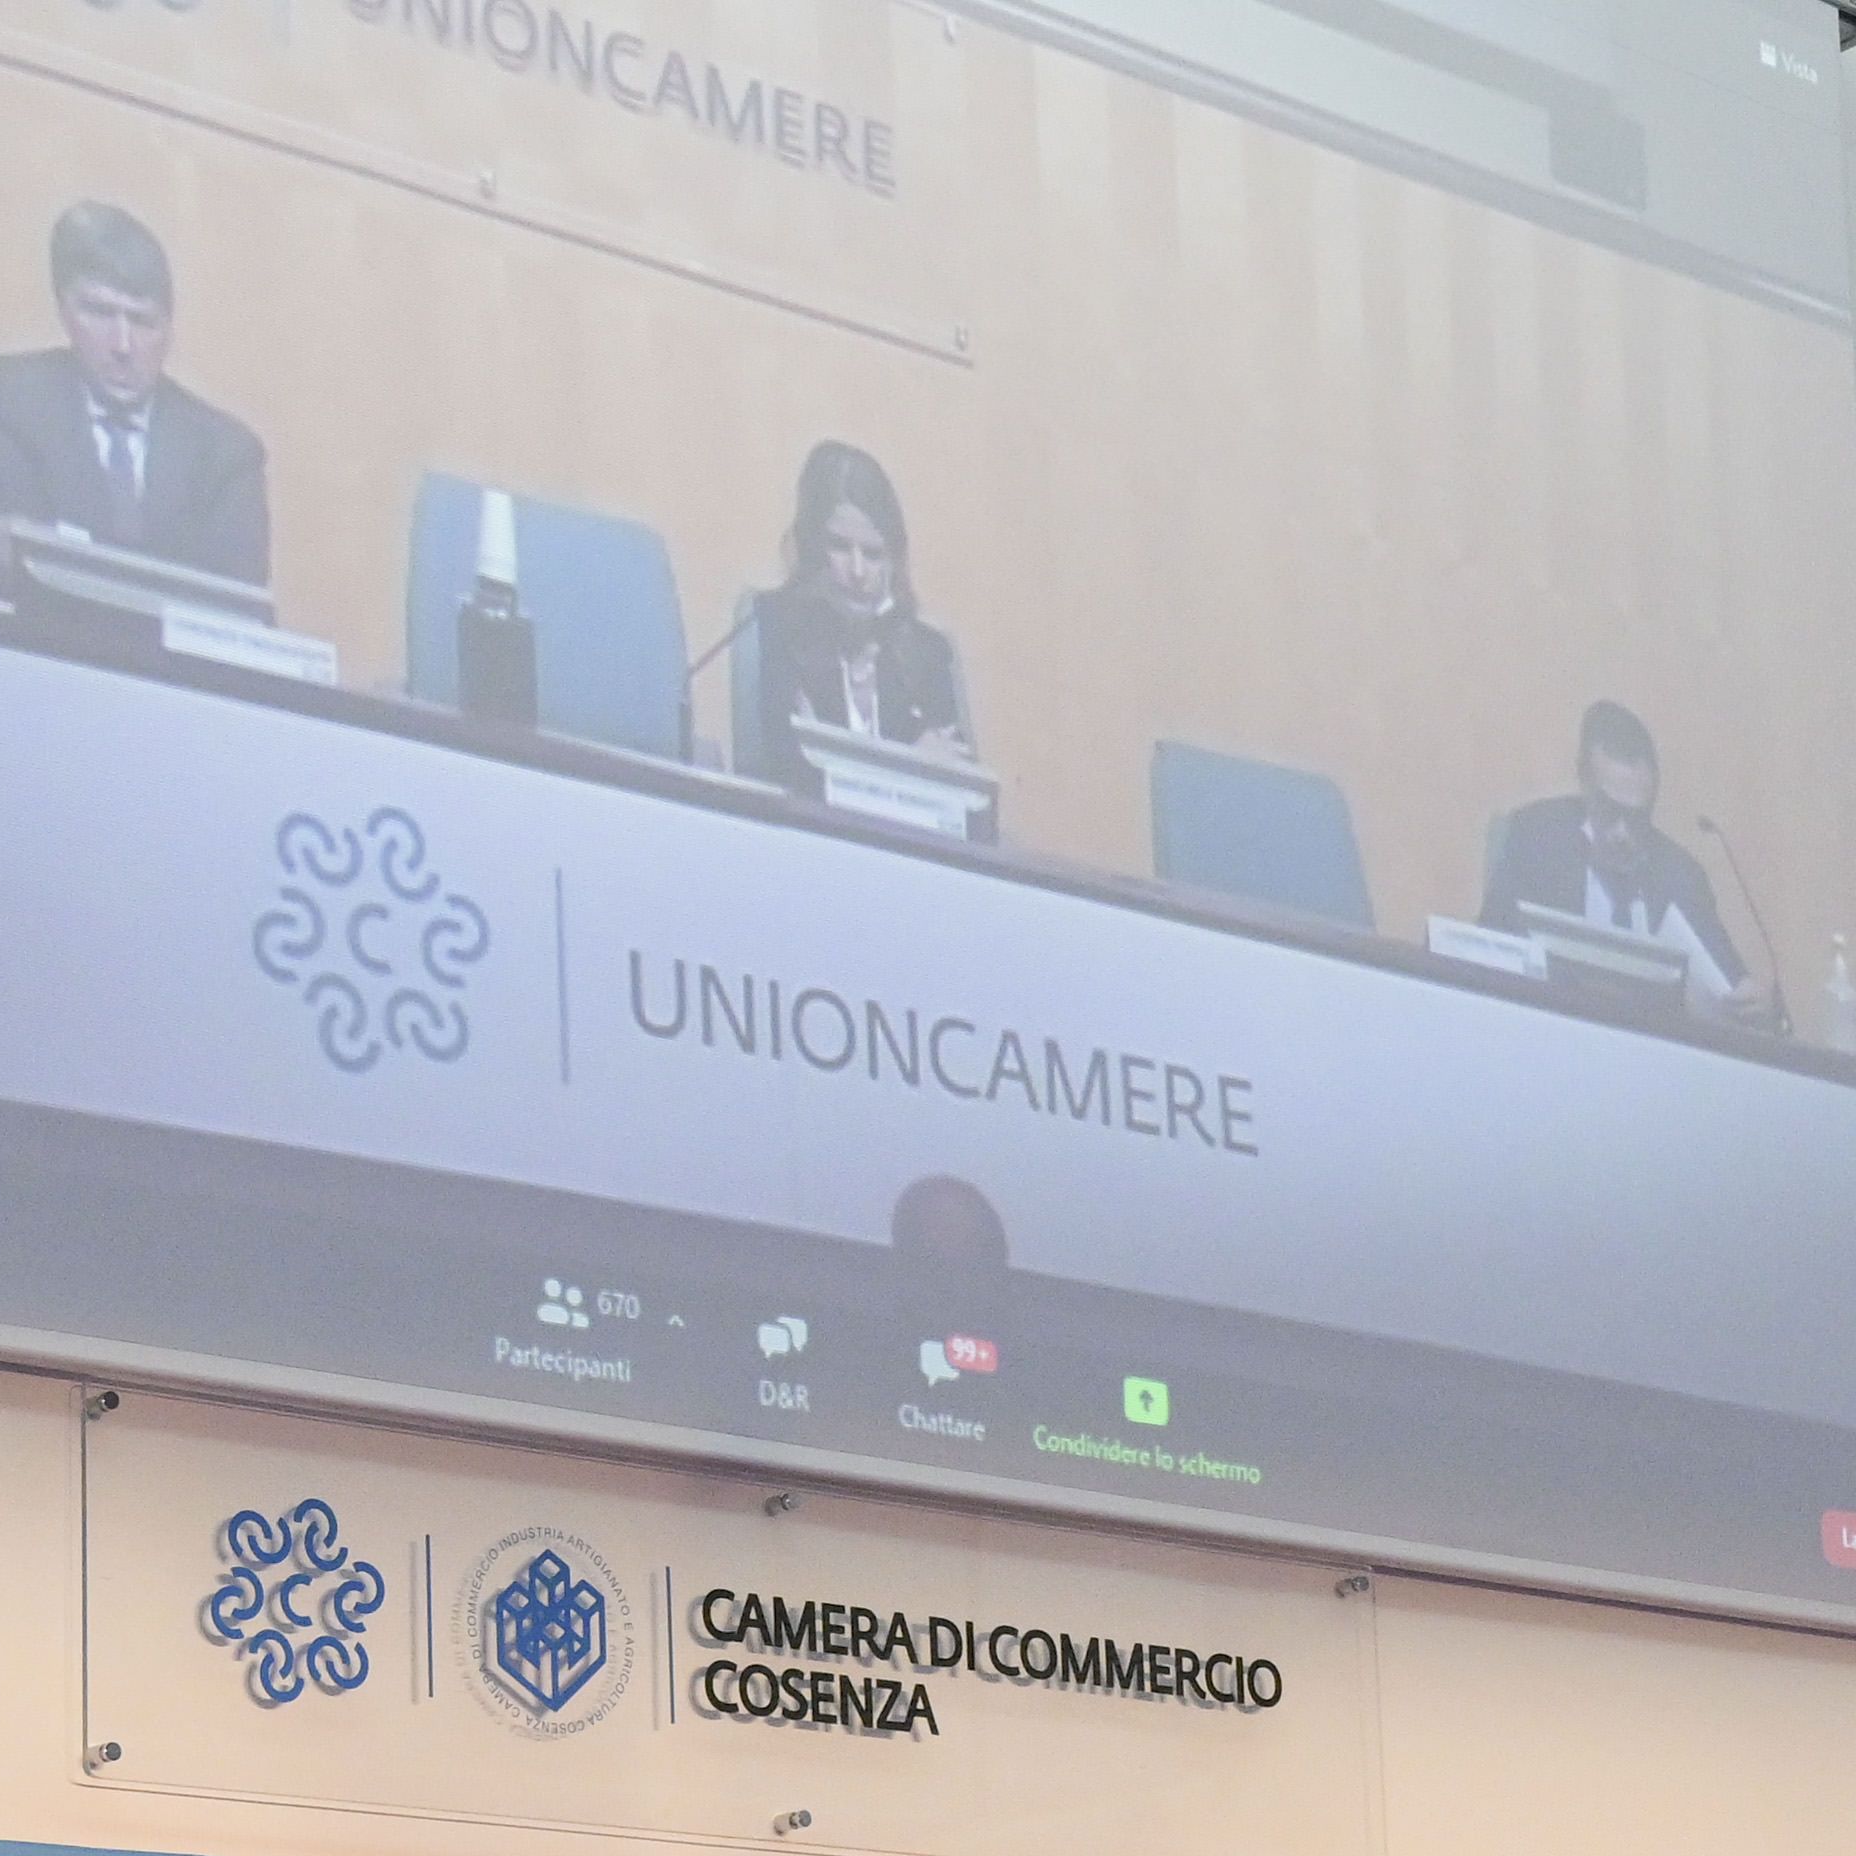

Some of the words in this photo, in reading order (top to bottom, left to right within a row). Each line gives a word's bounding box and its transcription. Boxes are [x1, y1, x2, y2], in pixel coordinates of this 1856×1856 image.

[1781, 50, 1818, 83] Vista
[628, 949, 1260, 1157] UNIONCAMERE
[597, 1290, 640, 1319] 670
[495, 1335, 632, 1383] Partecipanti
[952, 1337, 991, 1364] 99+
[759, 1380, 810, 1413] D&R
[899, 1403, 985, 1442] Chattare
[1033, 1425, 1151, 1470] Condividere
[1153, 1444, 1175, 1472] lo
[1177, 1452, 1261, 1485] schermo
[499, 1526, 564, 1552] INDUSTRIA
[467, 1547, 500, 1639] COMMERCIO
[566, 1533, 631, 1617] ARTIGIANATO
[701, 1587, 918, 1664] CAMERA
[929, 1615, 975, 1671] DI
[988, 1624, 1283, 1708] COMMERCIO
[587, 1635, 635, 1727] AGRICOLTURA
[704, 1659, 939, 1736] COSENZA
[525, 1713, 586, 1735] COSENZA
